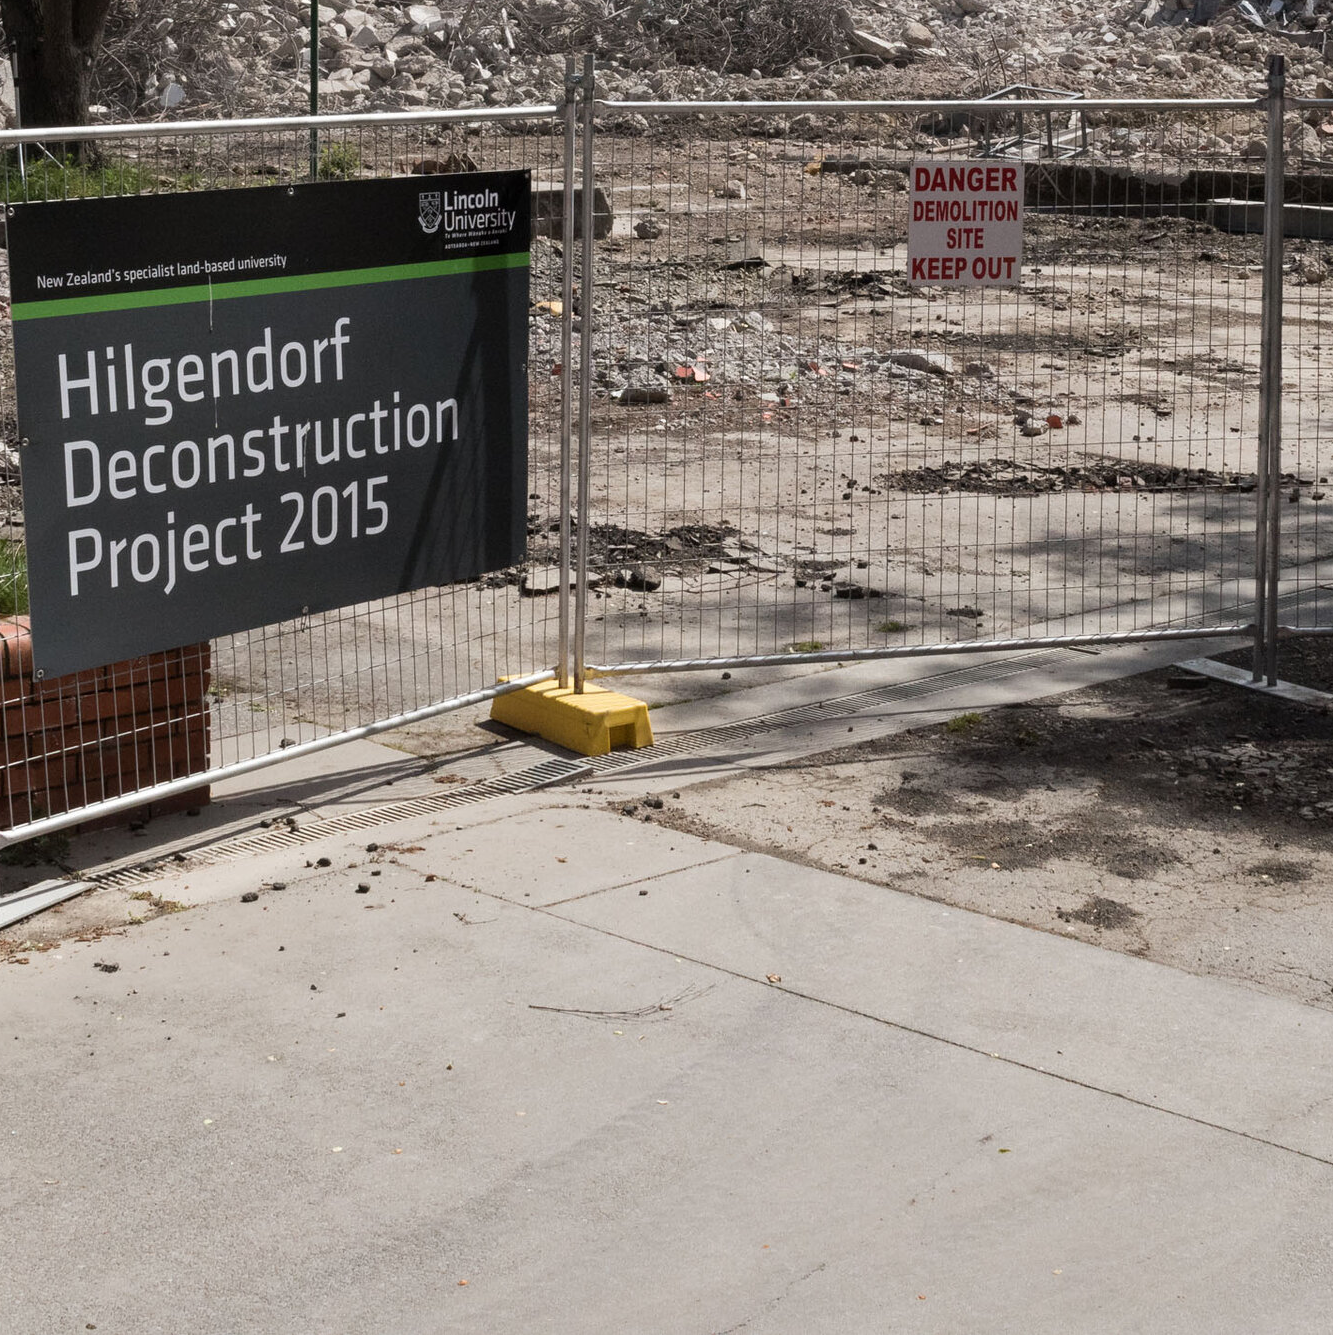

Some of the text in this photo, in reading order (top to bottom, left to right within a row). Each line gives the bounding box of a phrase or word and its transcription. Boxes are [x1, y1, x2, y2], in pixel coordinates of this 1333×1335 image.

[915, 167, 1017, 192] DANGER
[444, 188, 499, 210] Lincoln
[913, 200, 1018, 222] DEMOLITION
[444, 208, 516, 231] University
[946, 228, 984, 249] SITE
[37, 254, 287, 289] New Zealand's specialist land-based university
[912, 256, 1016, 280] KEEP OUT
[58, 317, 351, 425] Hilgendorf
[63, 391, 460, 508] Deconstruction
[67, 476, 390, 596] Project 2015
